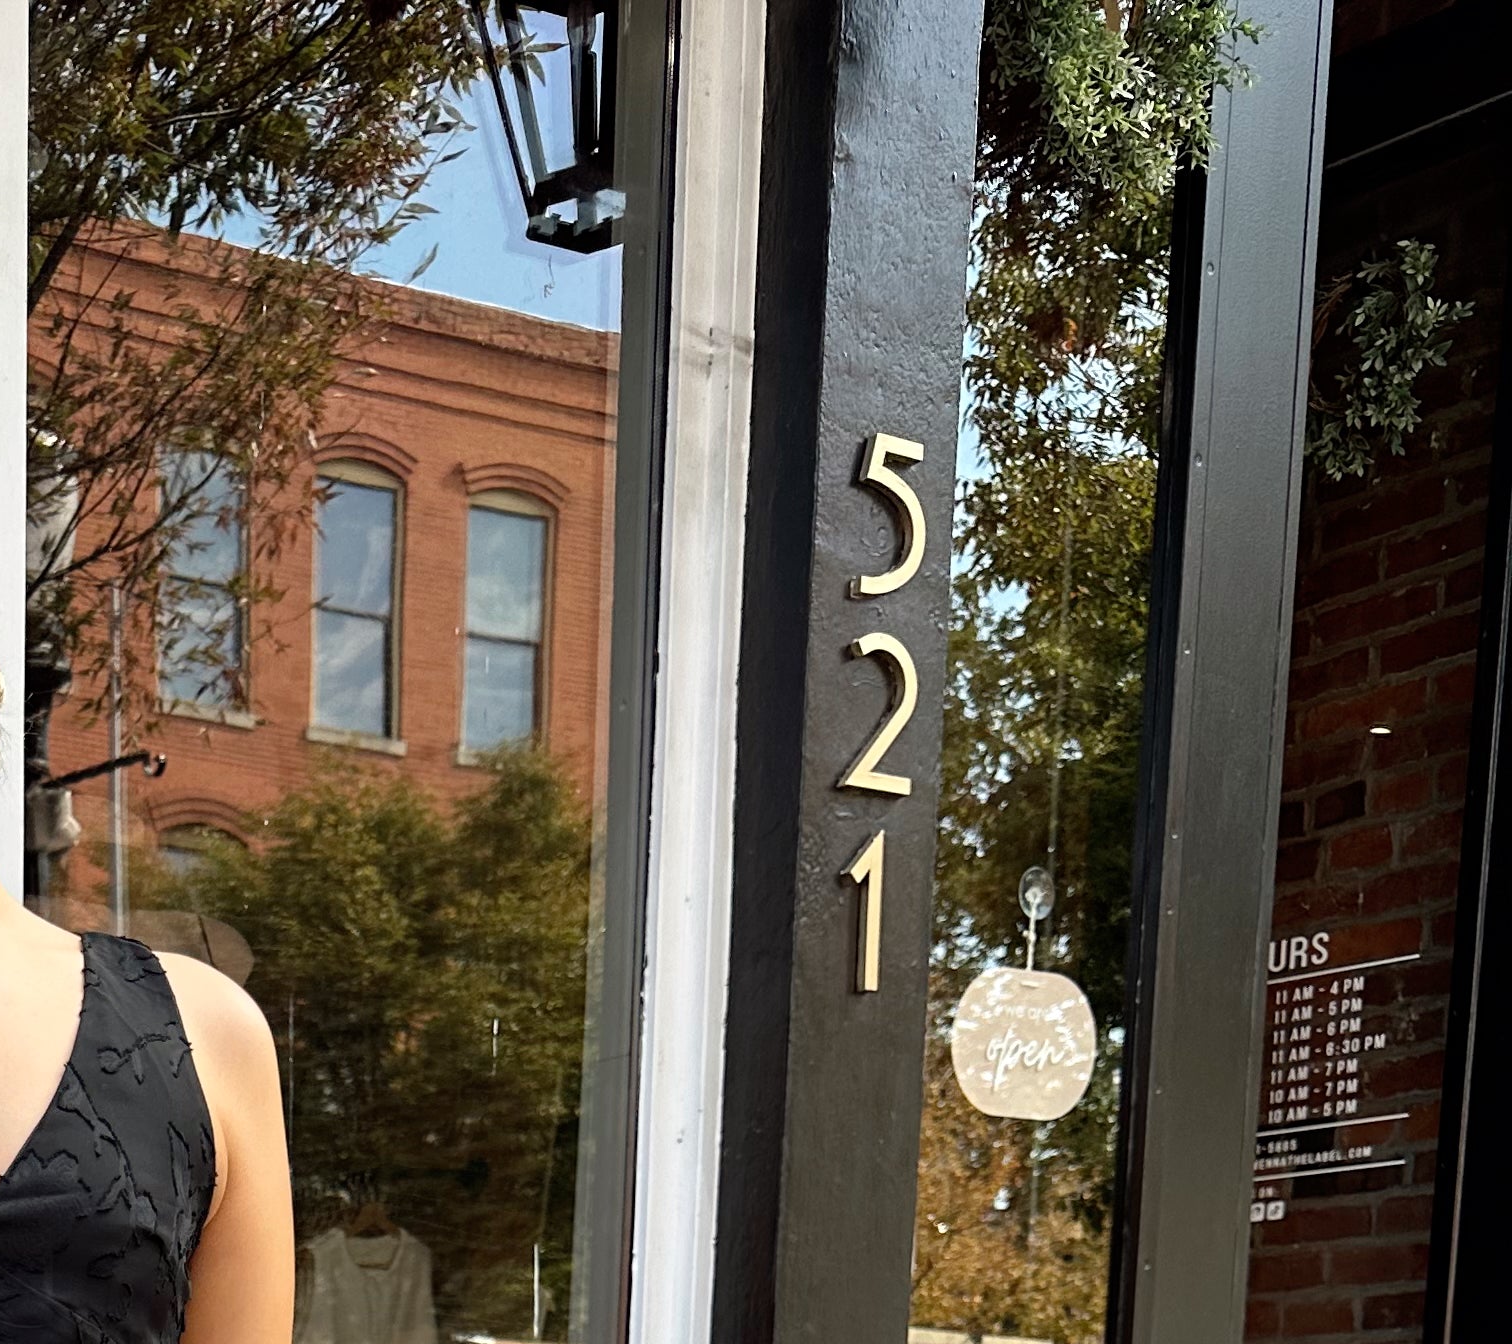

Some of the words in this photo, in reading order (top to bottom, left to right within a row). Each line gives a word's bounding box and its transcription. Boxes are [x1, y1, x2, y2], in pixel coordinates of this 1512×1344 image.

[837, 432, 926, 993] 521
[1268, 931, 1330, 973] URS
[1275, 989, 1288, 1006] 11
[1292, 984, 1314, 1002] AM
[1329, 980, 1339, 995] 4
[1343, 975, 1365, 994] PM
[1274, 1009, 1287, 1025] 11
[1291, 1004, 1313, 1022] AM
[1341, 997, 1363, 1014] PM
[1273, 1029, 1286, 1045] 11
[1289, 1024, 1311, 1042] AM
[1326, 1021, 1336, 1037] 6
[1339, 1016, 1361, 1034] PM
[986, 1023, 1065, 1092] open
[1271, 1049, 1284, 1065] 11
[1288, 1044, 1311, 1062] AM
[1325, 1037, 1361, 1057] 6:30
[1364, 1032, 1386, 1051] PM
[1270, 1069, 1283, 1085] 11
[1287, 1064, 1309, 1082] AM
[1324, 1061, 1333, 1077] 7
[1336, 1057, 1358, 1076] PM
[1269, 1088, 1284, 1105] 10
[1287, 1084, 1309, 1102] AM
[1324, 1080, 1333, 1097] 7
[1336, 1077, 1358, 1095] PM
[1268, 1108, 1283, 1125] 10
[1286, 1104, 1308, 1122] AM
[1335, 1097, 1357, 1115] PM
